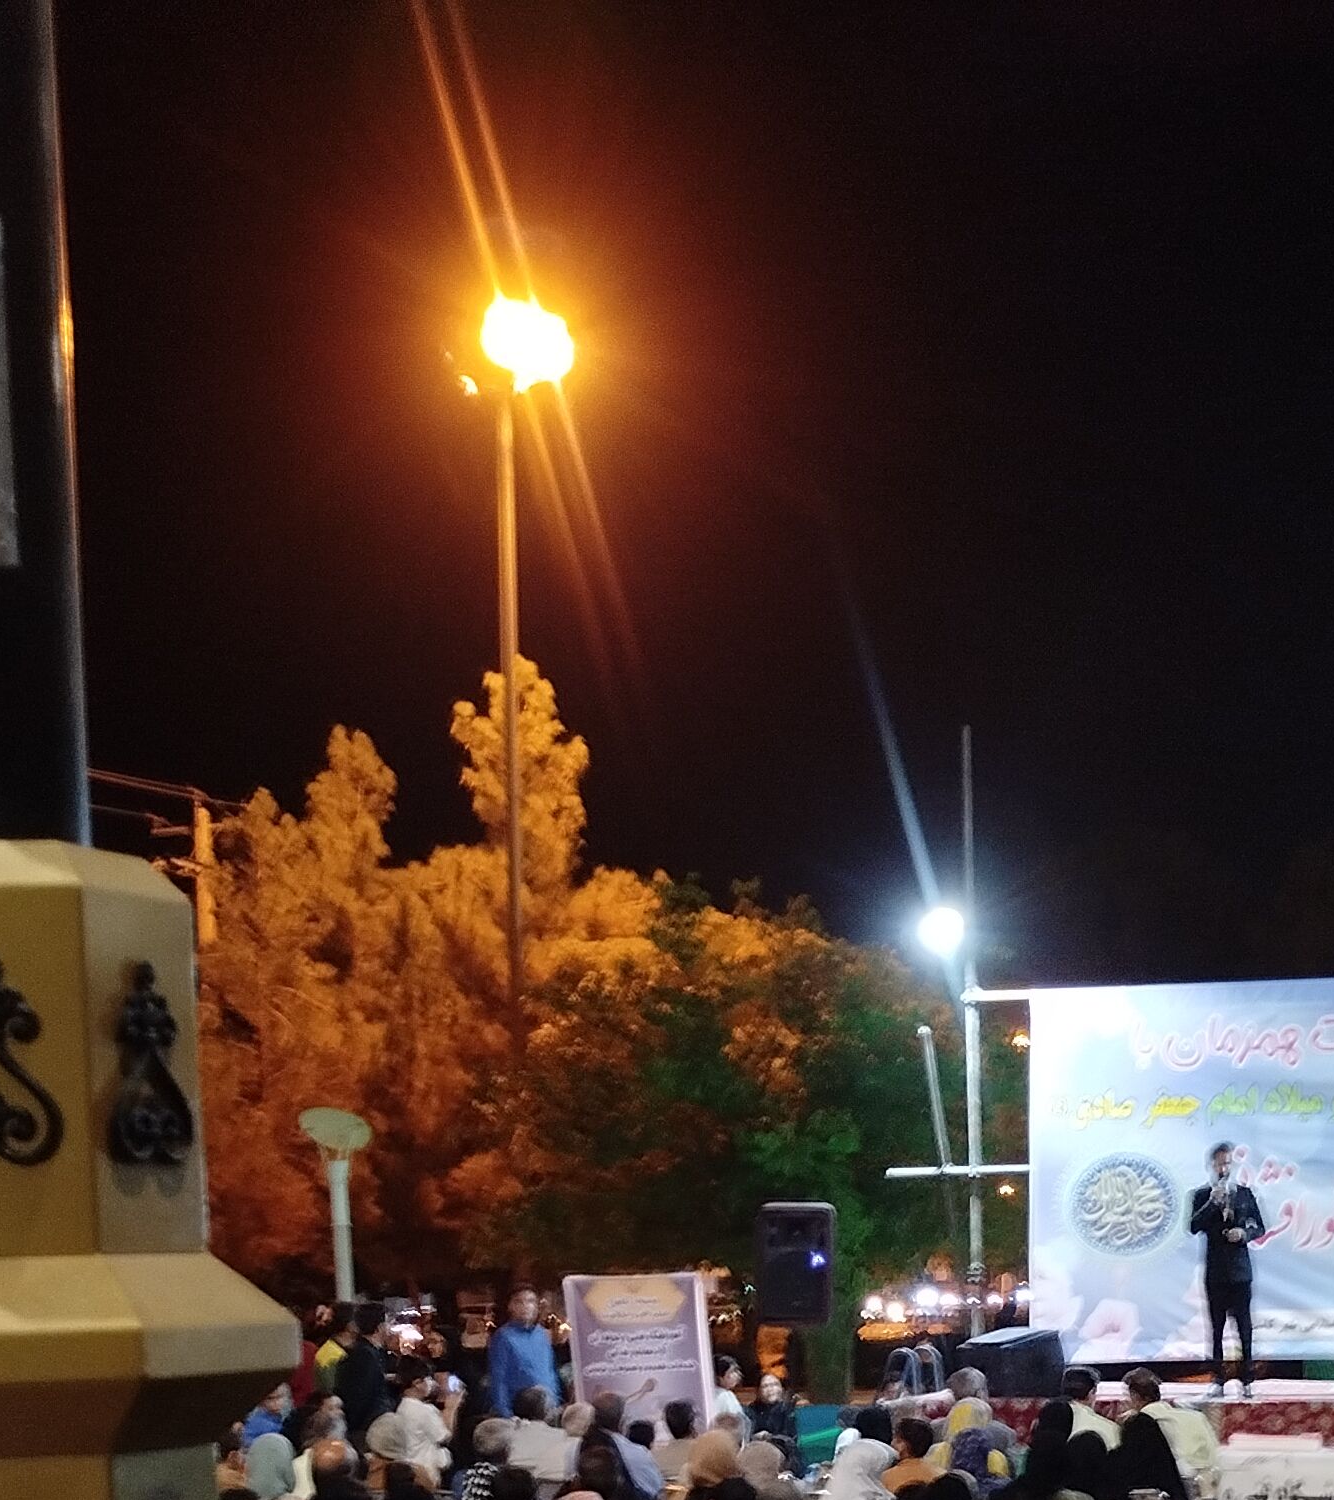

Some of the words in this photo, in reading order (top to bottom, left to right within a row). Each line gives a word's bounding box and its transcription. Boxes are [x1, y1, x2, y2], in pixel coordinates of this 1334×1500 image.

[1163, 1014, 1302, 1071] همزمان
[1068, 1088, 1137, 1130] صادق
[1140, 1088, 1201, 1129] جعفر
[1206, 1084, 1259, 1125] امام
[1263, 1081, 1323, 1121] میلاد
